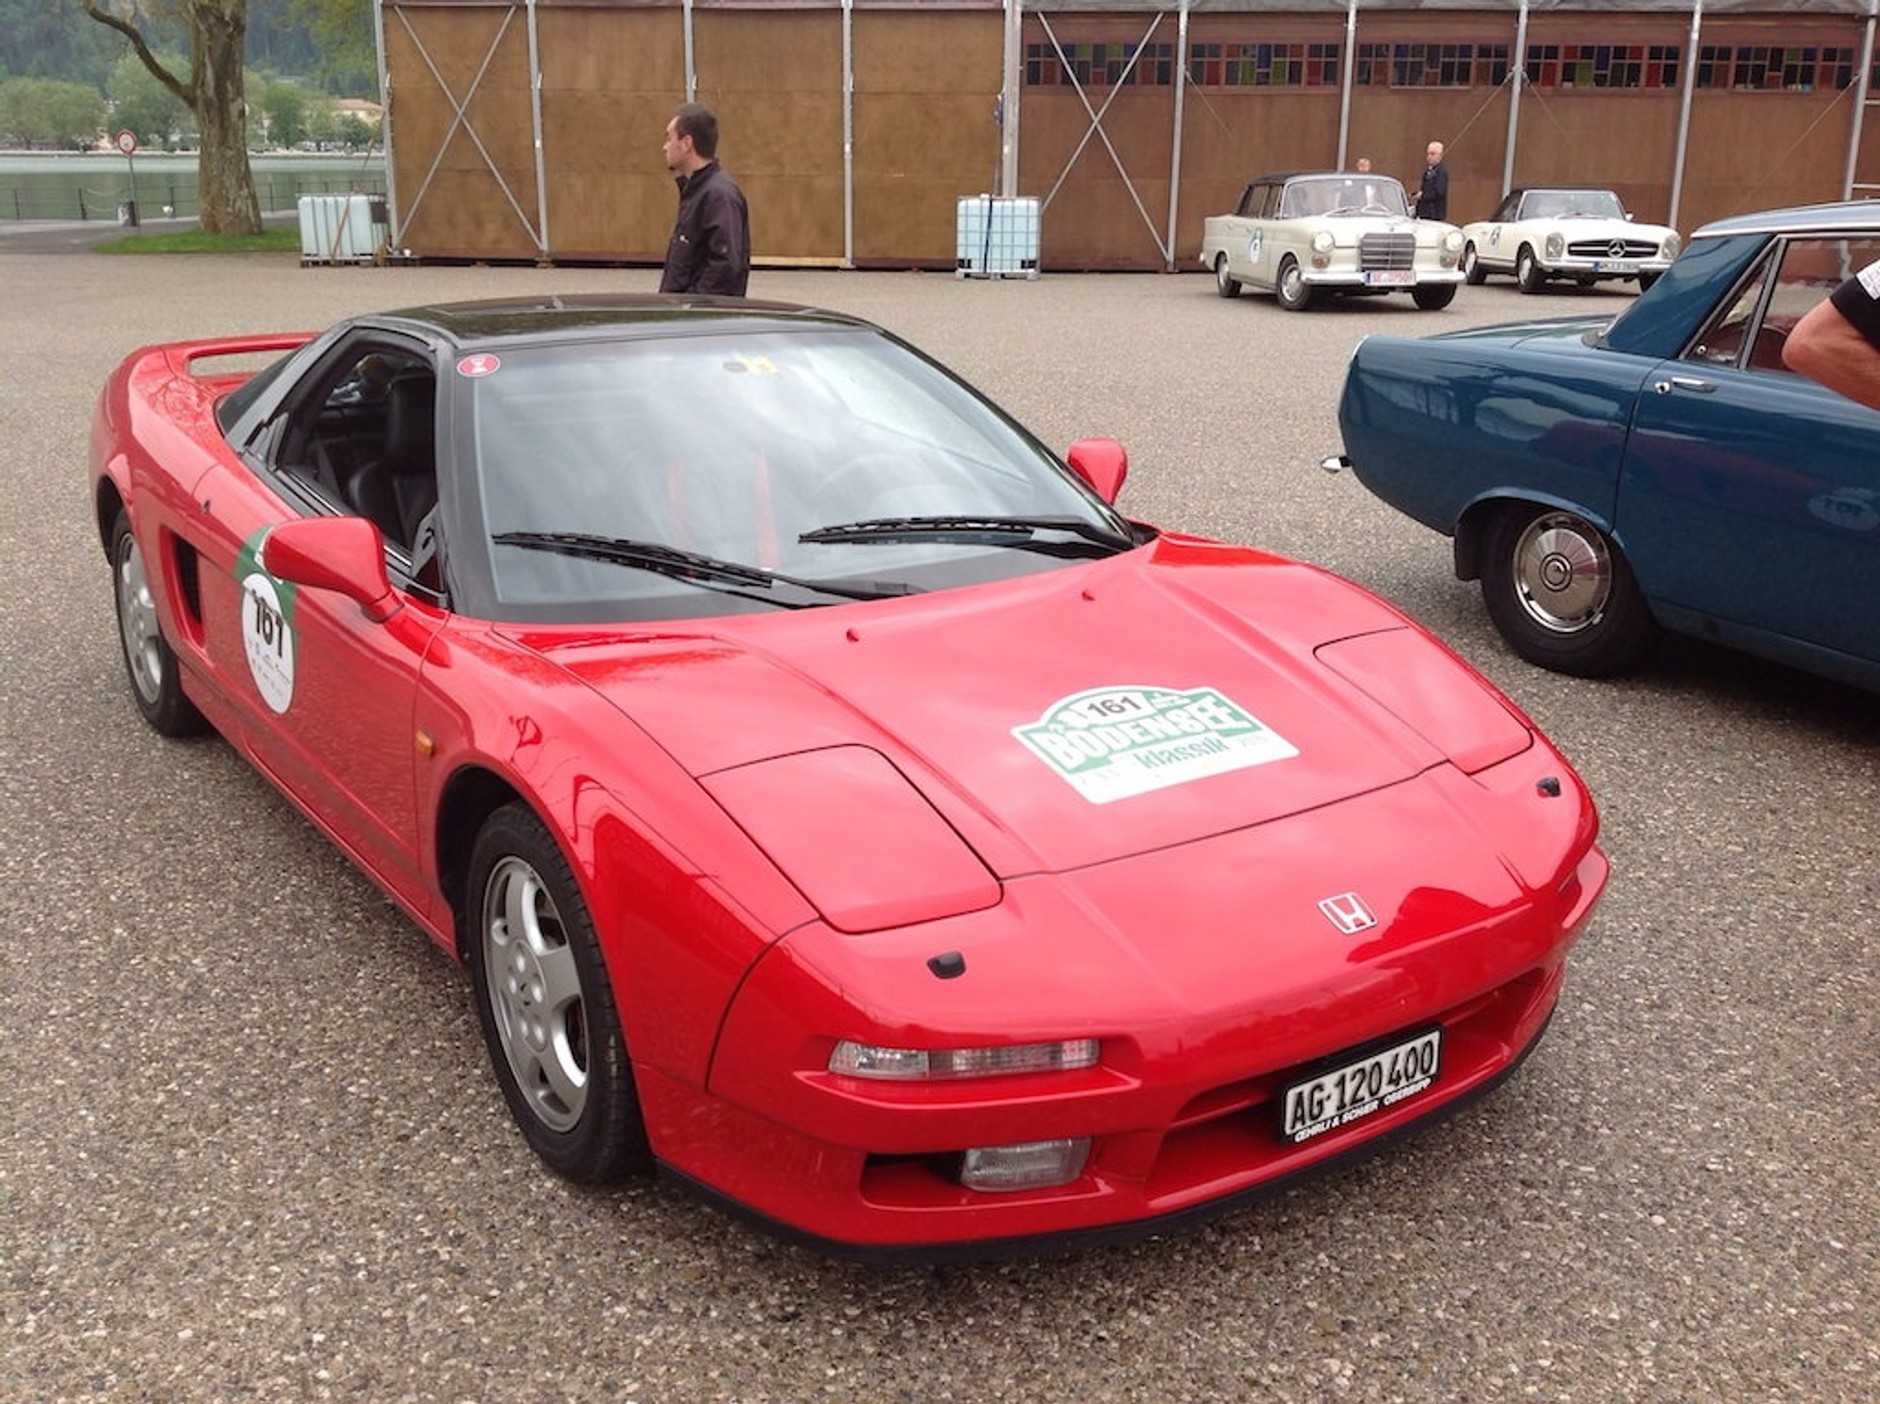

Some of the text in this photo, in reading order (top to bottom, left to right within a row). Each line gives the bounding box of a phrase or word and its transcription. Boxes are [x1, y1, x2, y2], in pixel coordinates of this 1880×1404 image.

[1087, 695, 1143, 718] 161
[1030, 696, 1252, 768] BODENSEE
[1133, 734, 1231, 770] klassik
